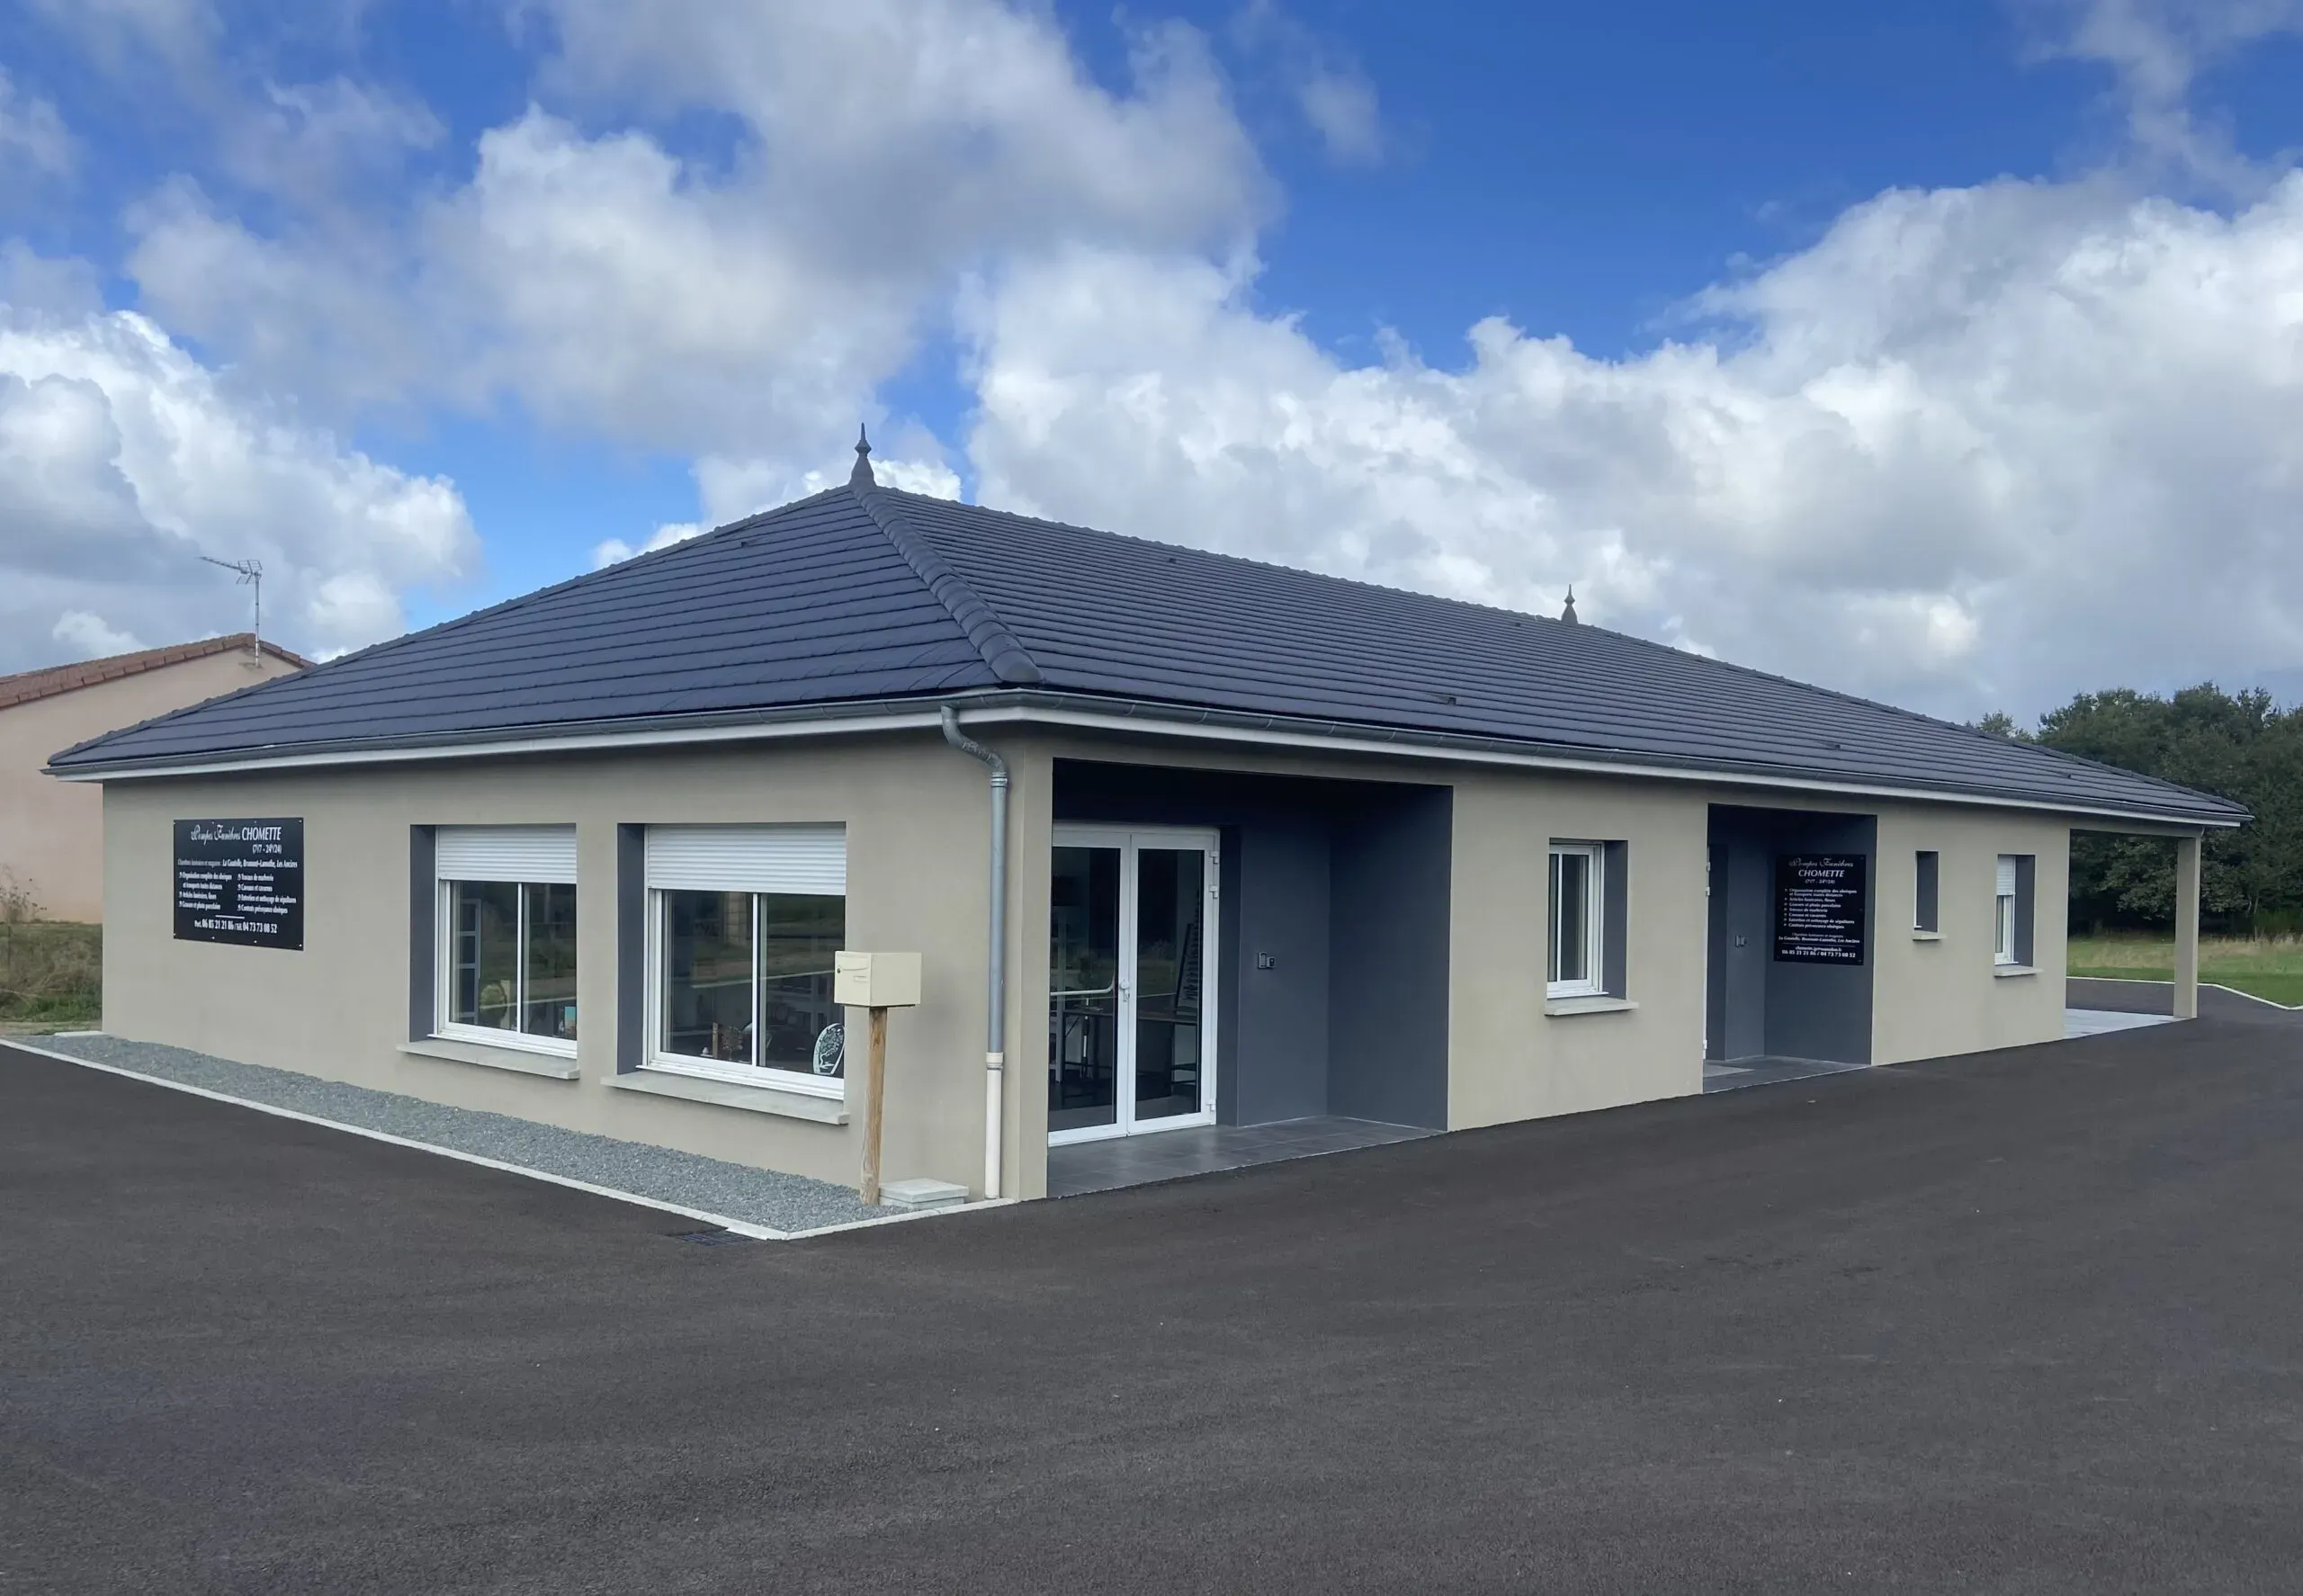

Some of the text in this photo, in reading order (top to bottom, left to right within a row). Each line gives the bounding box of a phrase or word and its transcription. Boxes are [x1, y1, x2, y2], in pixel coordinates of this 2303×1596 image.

[191, 824, 282, 846] Pompes Funèbres CHOMETTE
[1788, 857, 1853, 869] Pompes Funèbres
[1798, 869, 1845, 877] CHOMETTE
